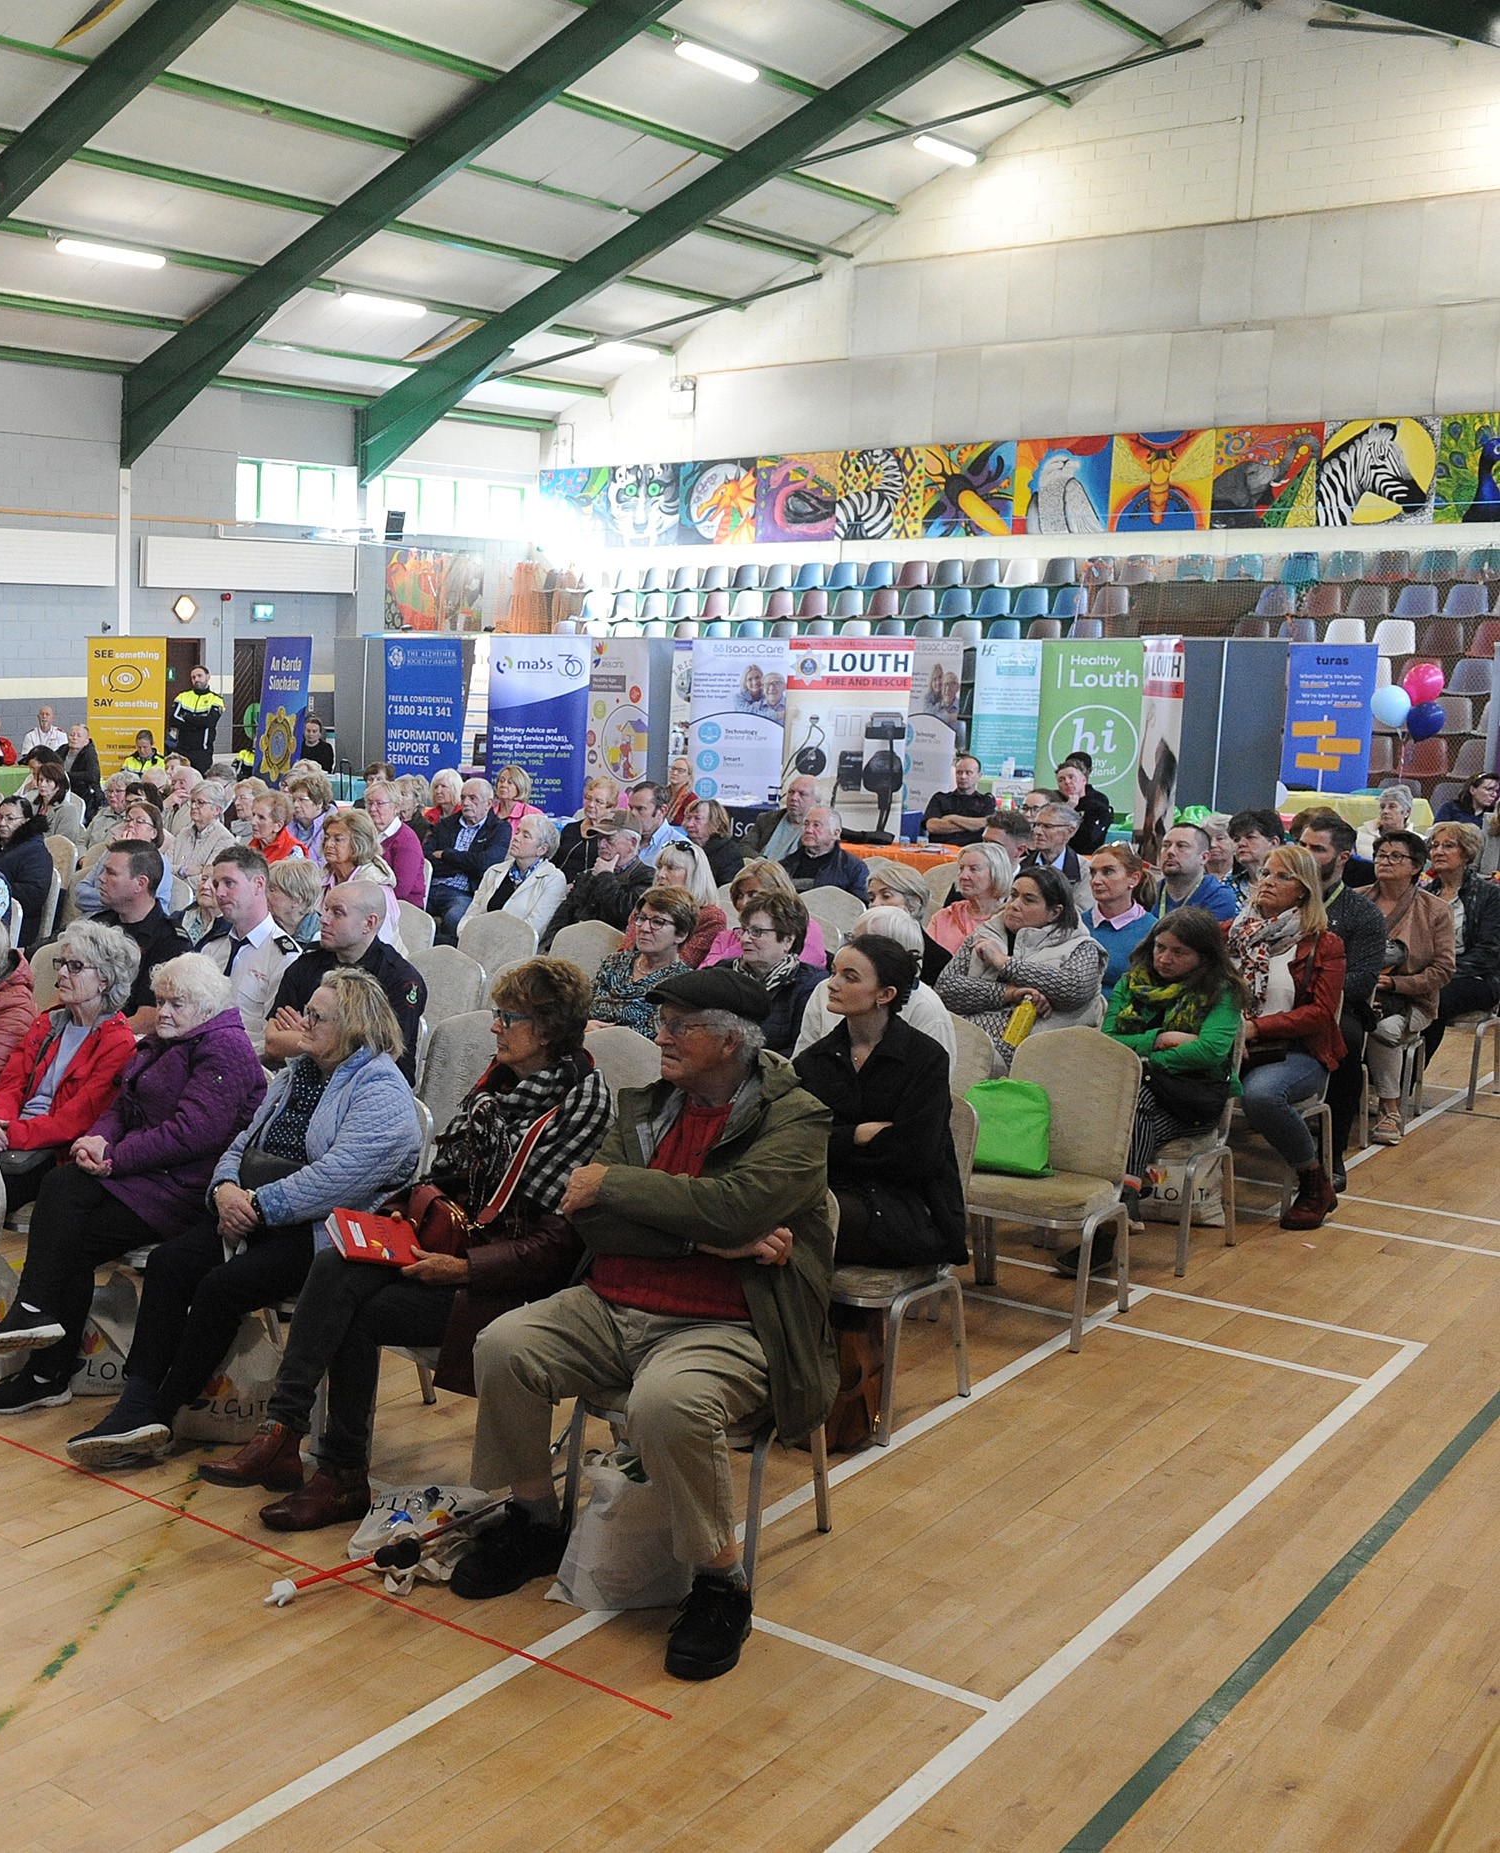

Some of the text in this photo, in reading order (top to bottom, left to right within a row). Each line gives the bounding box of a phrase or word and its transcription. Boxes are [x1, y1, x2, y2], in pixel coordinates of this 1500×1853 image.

[726, 644, 784, 653] Isaac Care
[94, 650, 160, 660] SEE something
[1070, 655, 1121, 667] Healthy
[1316, 656, 1349, 665] turas
[270, 656, 302, 671] An Garda
[517, 658, 553, 670] mabs
[828, 653, 909, 672] LOUTH
[268, 675, 300, 690] Síochána
[1070, 670, 1138, 688] Louth
[94, 698, 158, 709] SAY something
[410, 696, 454, 704] CONFIDENTIAL
[394, 706, 451, 717] 1800 341 341
[388, 729, 458, 744] INFORMATION,
[492, 735, 522, 743] Budgeting
[1073, 718, 1117, 755] hi
[387, 741, 440, 754] SUPPORT &
[387, 754, 430, 766] SERVICES
